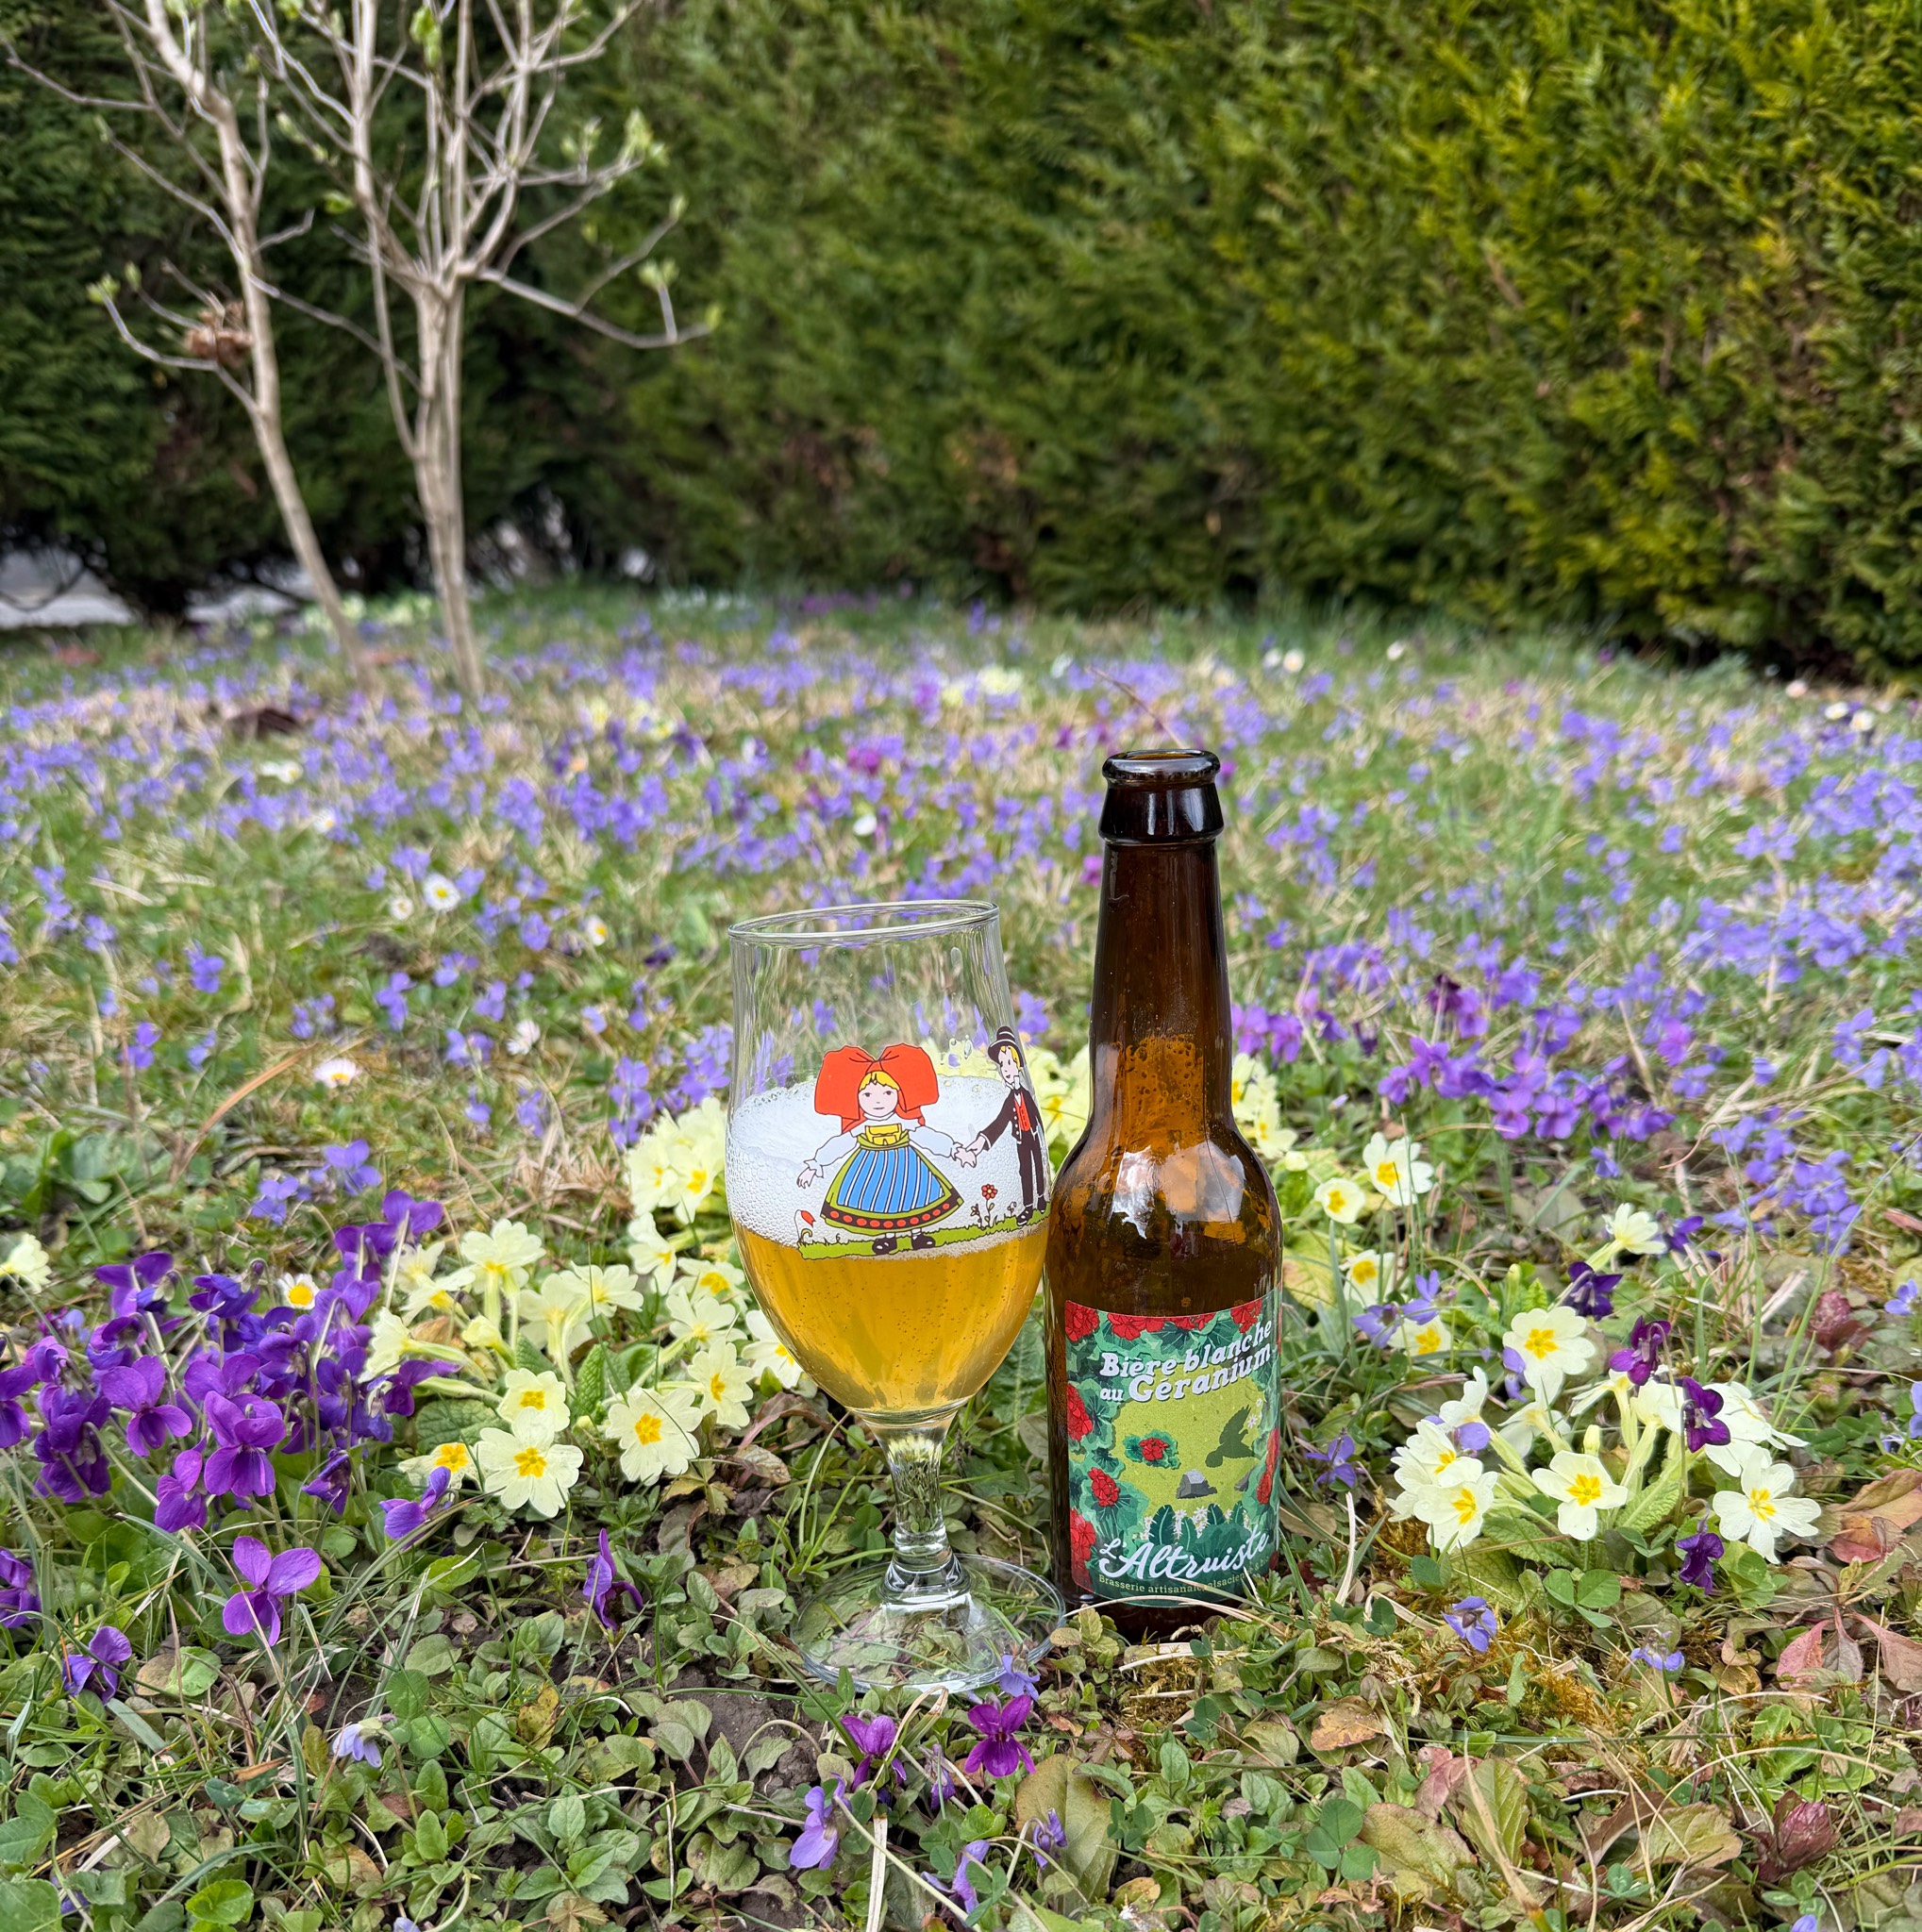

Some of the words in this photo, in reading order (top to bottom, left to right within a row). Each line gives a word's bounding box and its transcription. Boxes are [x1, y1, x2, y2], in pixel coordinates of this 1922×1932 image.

[1099, 1352, 1177, 1377] Bière
[1184, 1320, 1272, 1374] blanche
[1099, 1387, 1124, 1402] au
[1128, 1342, 1271, 1403] Géranium
[1098, 1524, 1269, 1580] L'Altruiste
[1098, 1574, 1145, 1592] Brasserie
